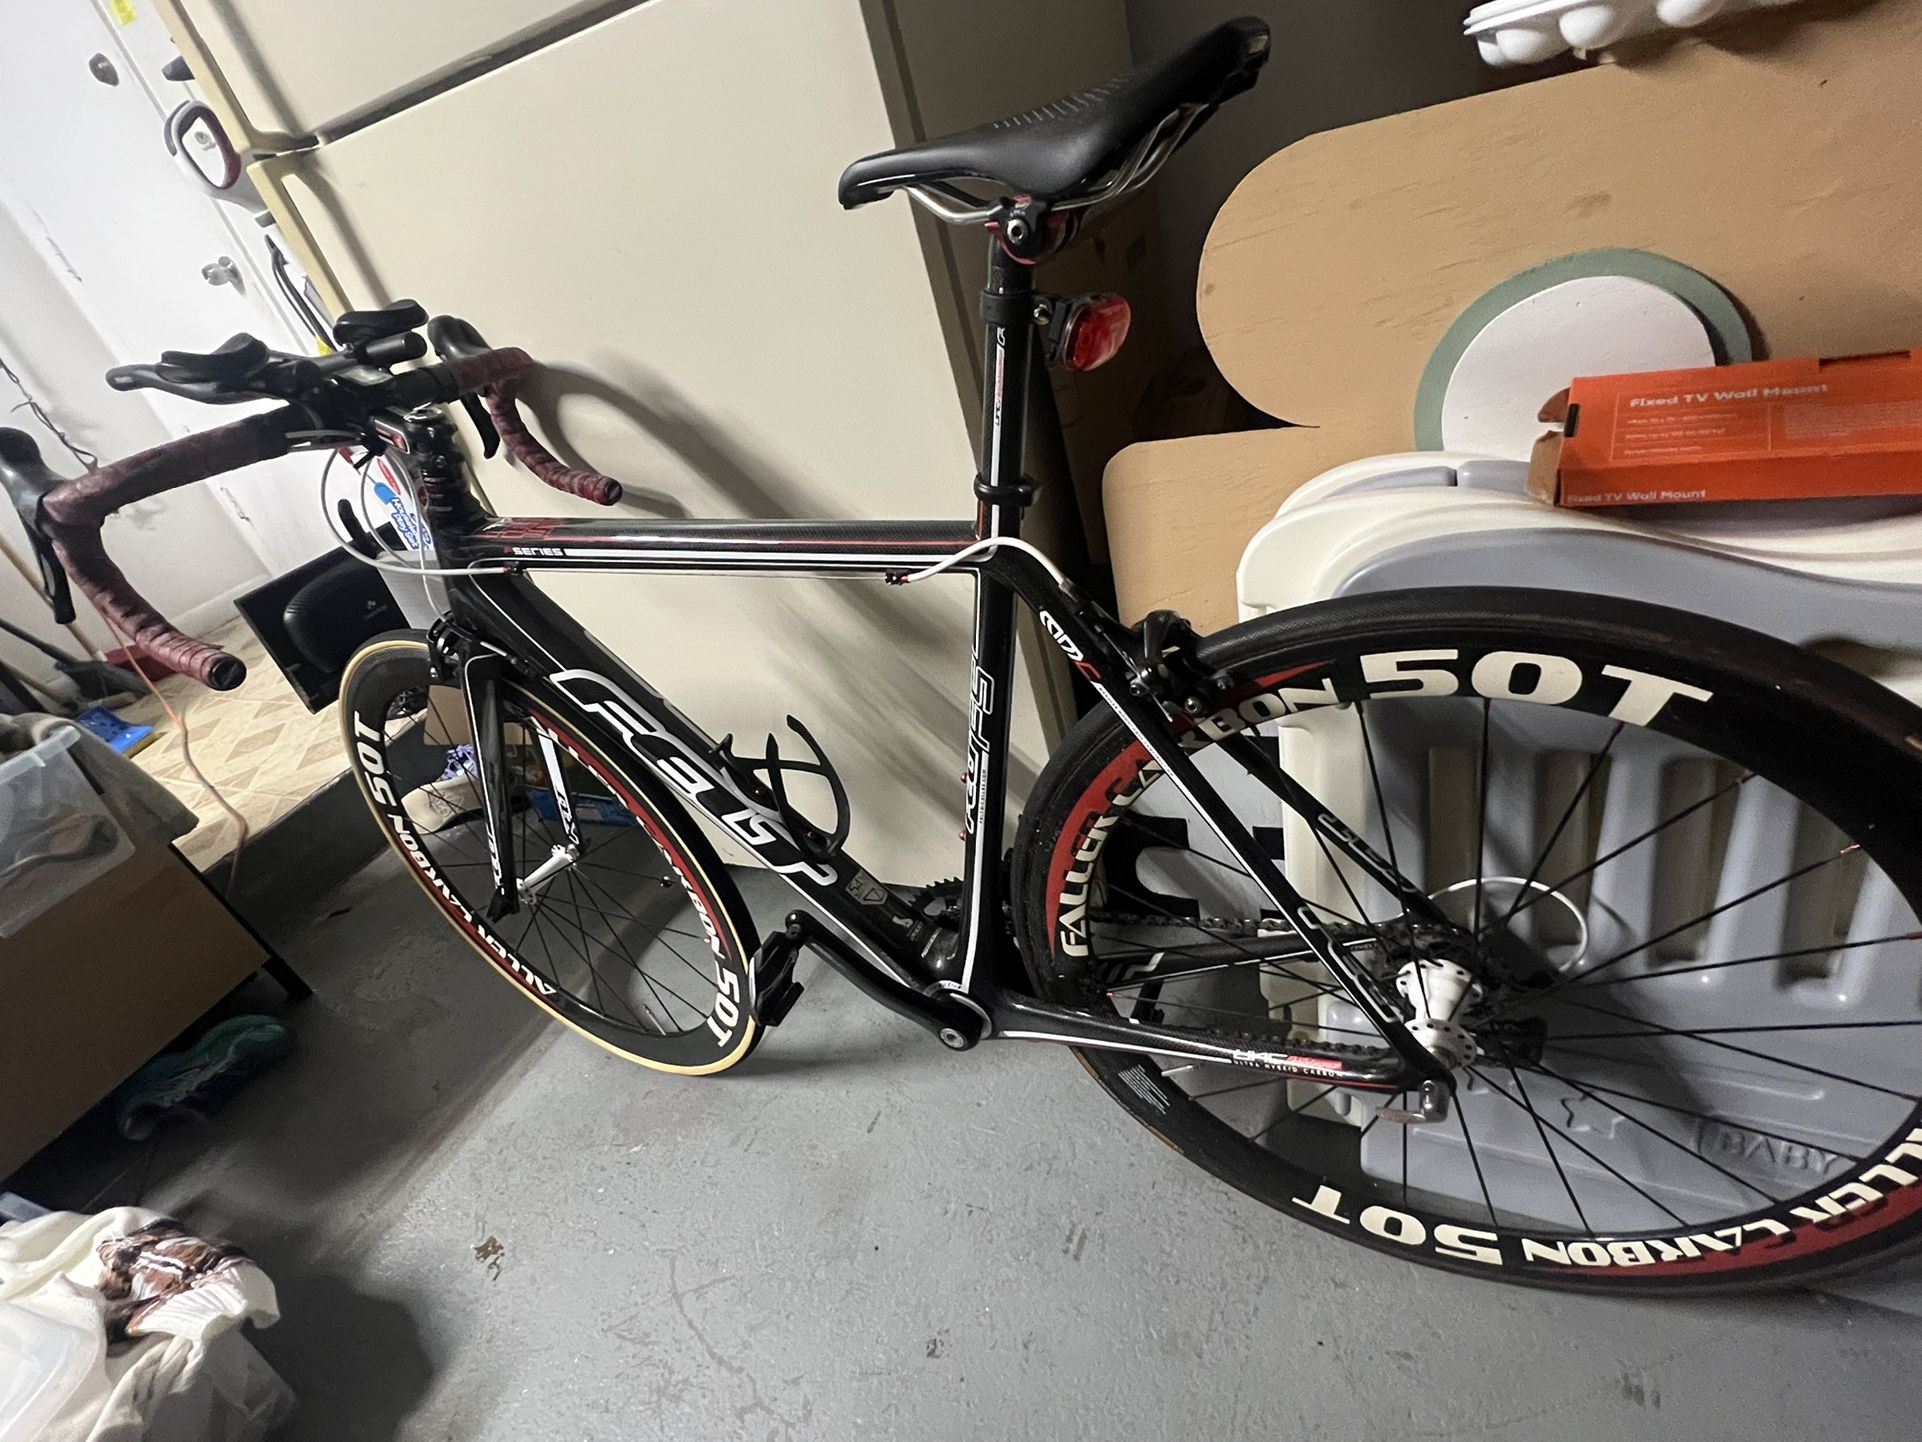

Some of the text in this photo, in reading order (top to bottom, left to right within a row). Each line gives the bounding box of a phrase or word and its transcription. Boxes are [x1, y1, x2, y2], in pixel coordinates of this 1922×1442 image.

[1629, 383, 1829, 408] Fixed TV Wall Mount
[1566, 488, 1707, 504] Fixed TV Wall Mount
[1359, 648, 1714, 728] 50T
[353, 709, 399, 808] 50T
[477, 924, 558, 996] ALLER
[706, 959, 741, 1048] 50T
[1291, 1183, 1503, 1266] 50T
